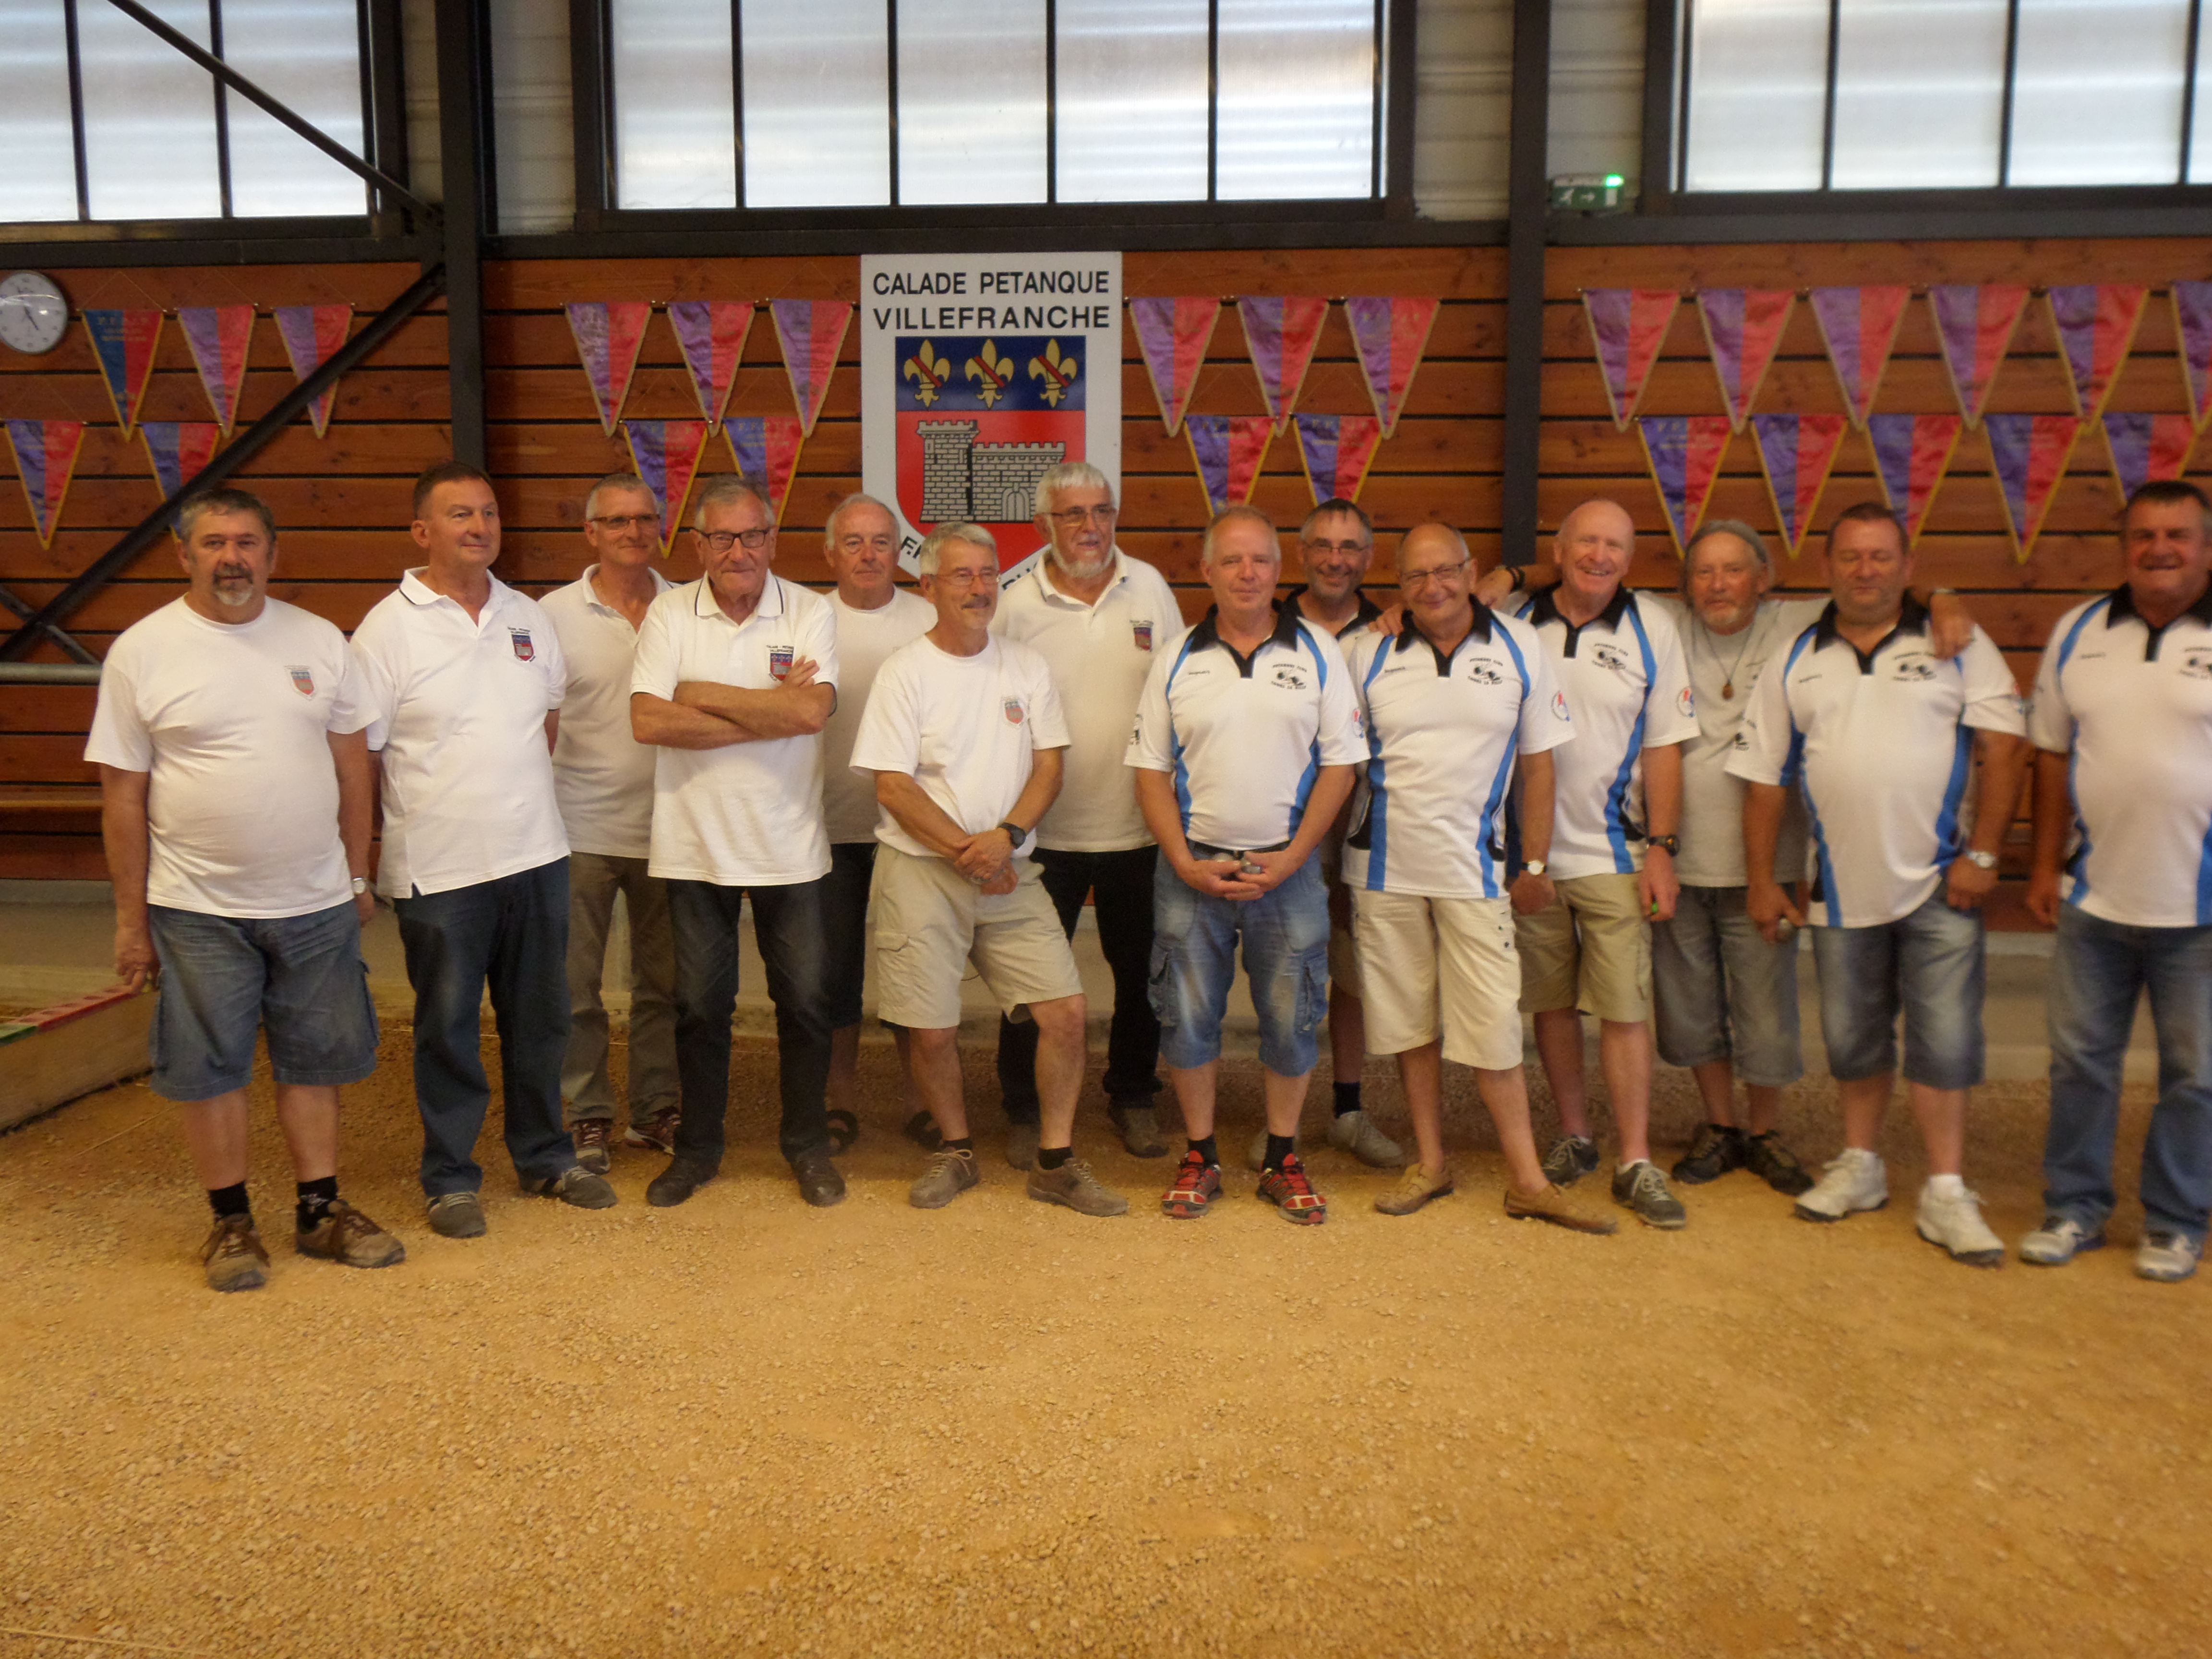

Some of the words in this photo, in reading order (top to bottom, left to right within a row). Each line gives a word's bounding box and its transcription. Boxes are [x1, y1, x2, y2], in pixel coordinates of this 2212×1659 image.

[873, 272, 966, 295] CALADE
[980, 270, 1109, 294] PETANQUE
[873, 306, 1109, 330] VILLEFRANCHE
